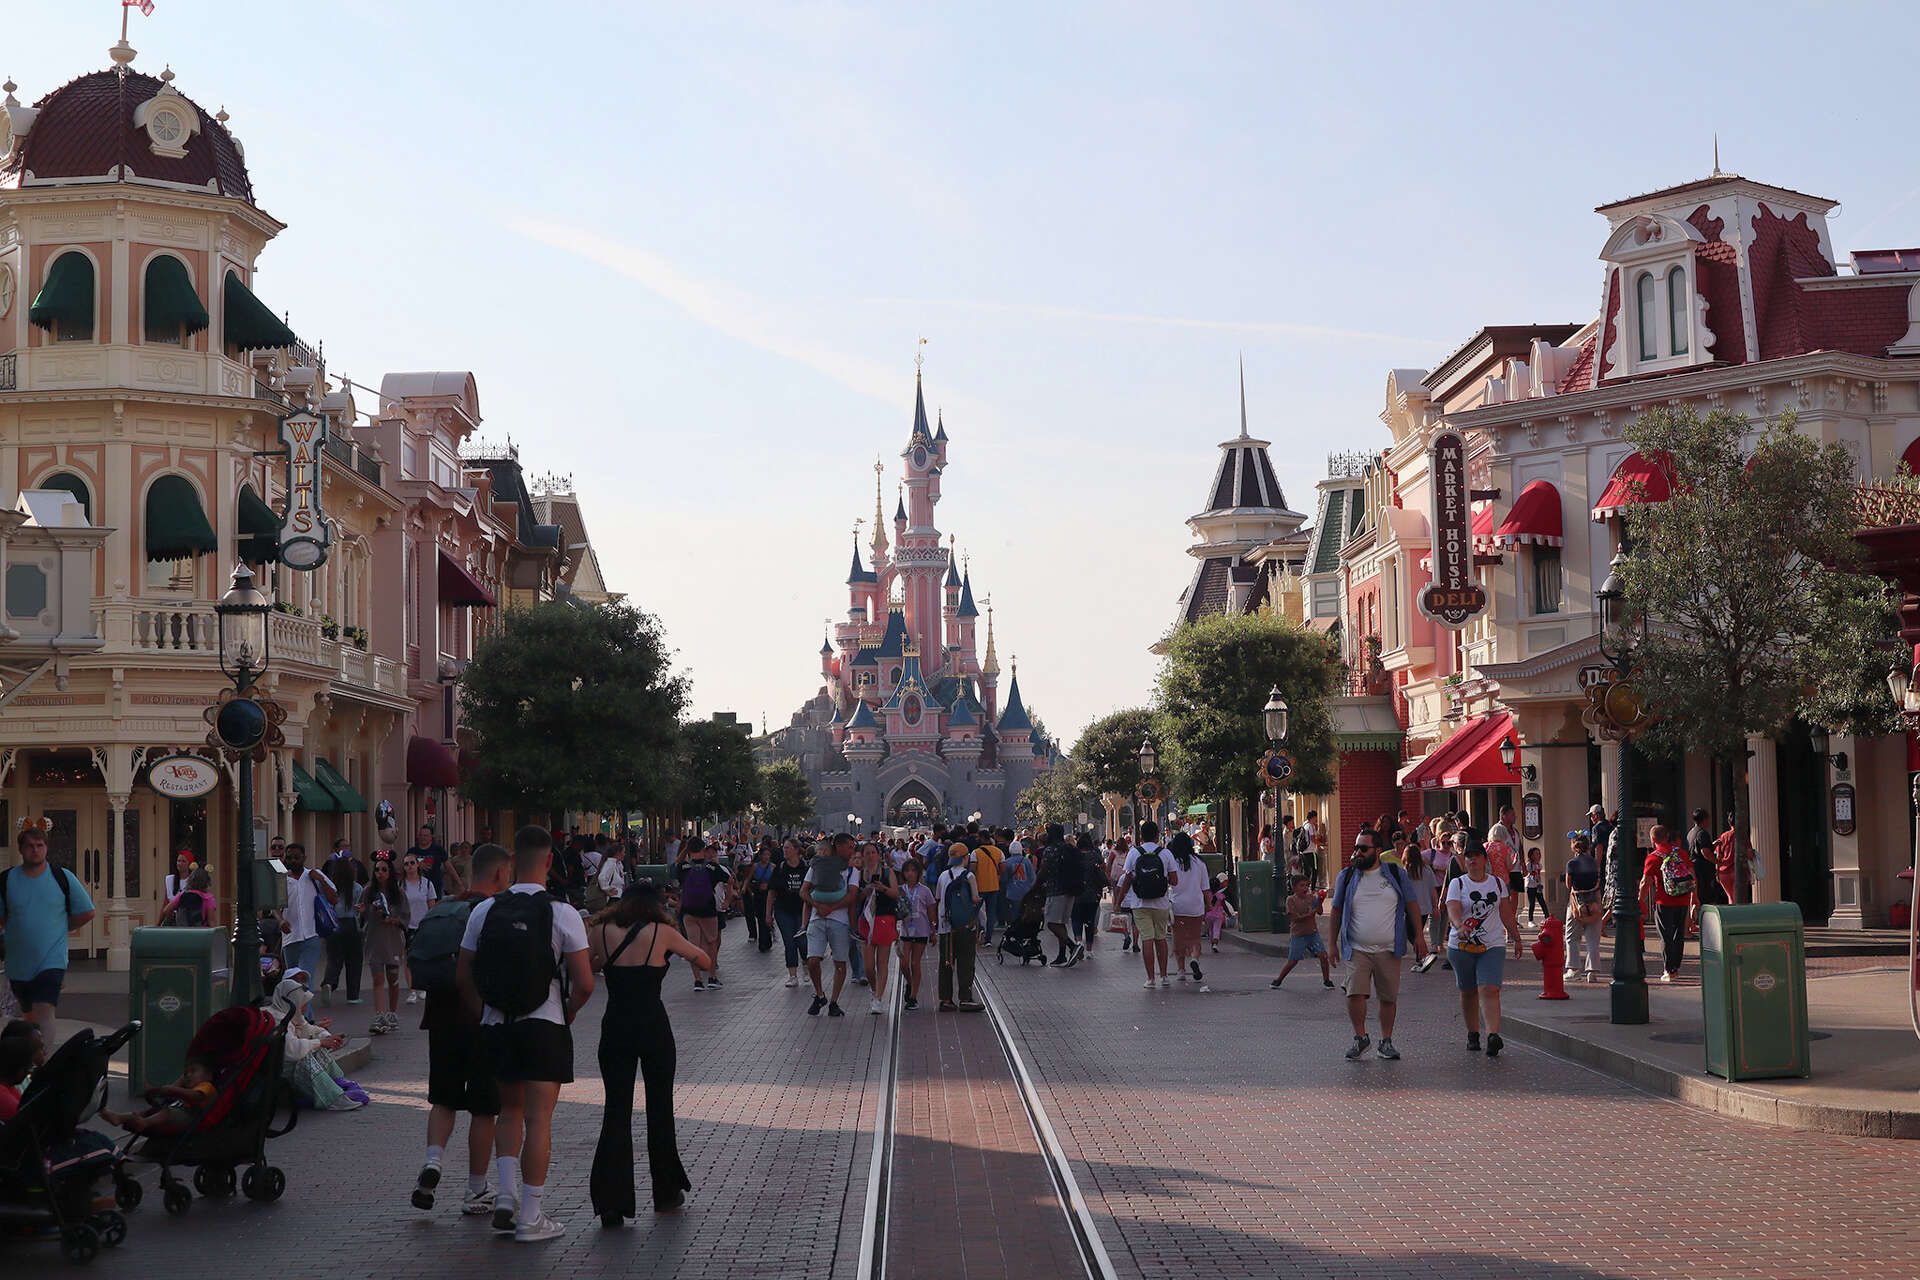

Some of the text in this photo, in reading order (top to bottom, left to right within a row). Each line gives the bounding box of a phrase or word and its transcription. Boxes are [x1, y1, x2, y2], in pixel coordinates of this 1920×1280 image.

[287, 421, 317, 533] WALTS
[1441, 447, 1461, 590] MARKET HOUSE
[1434, 593, 1477, 607] DELI
